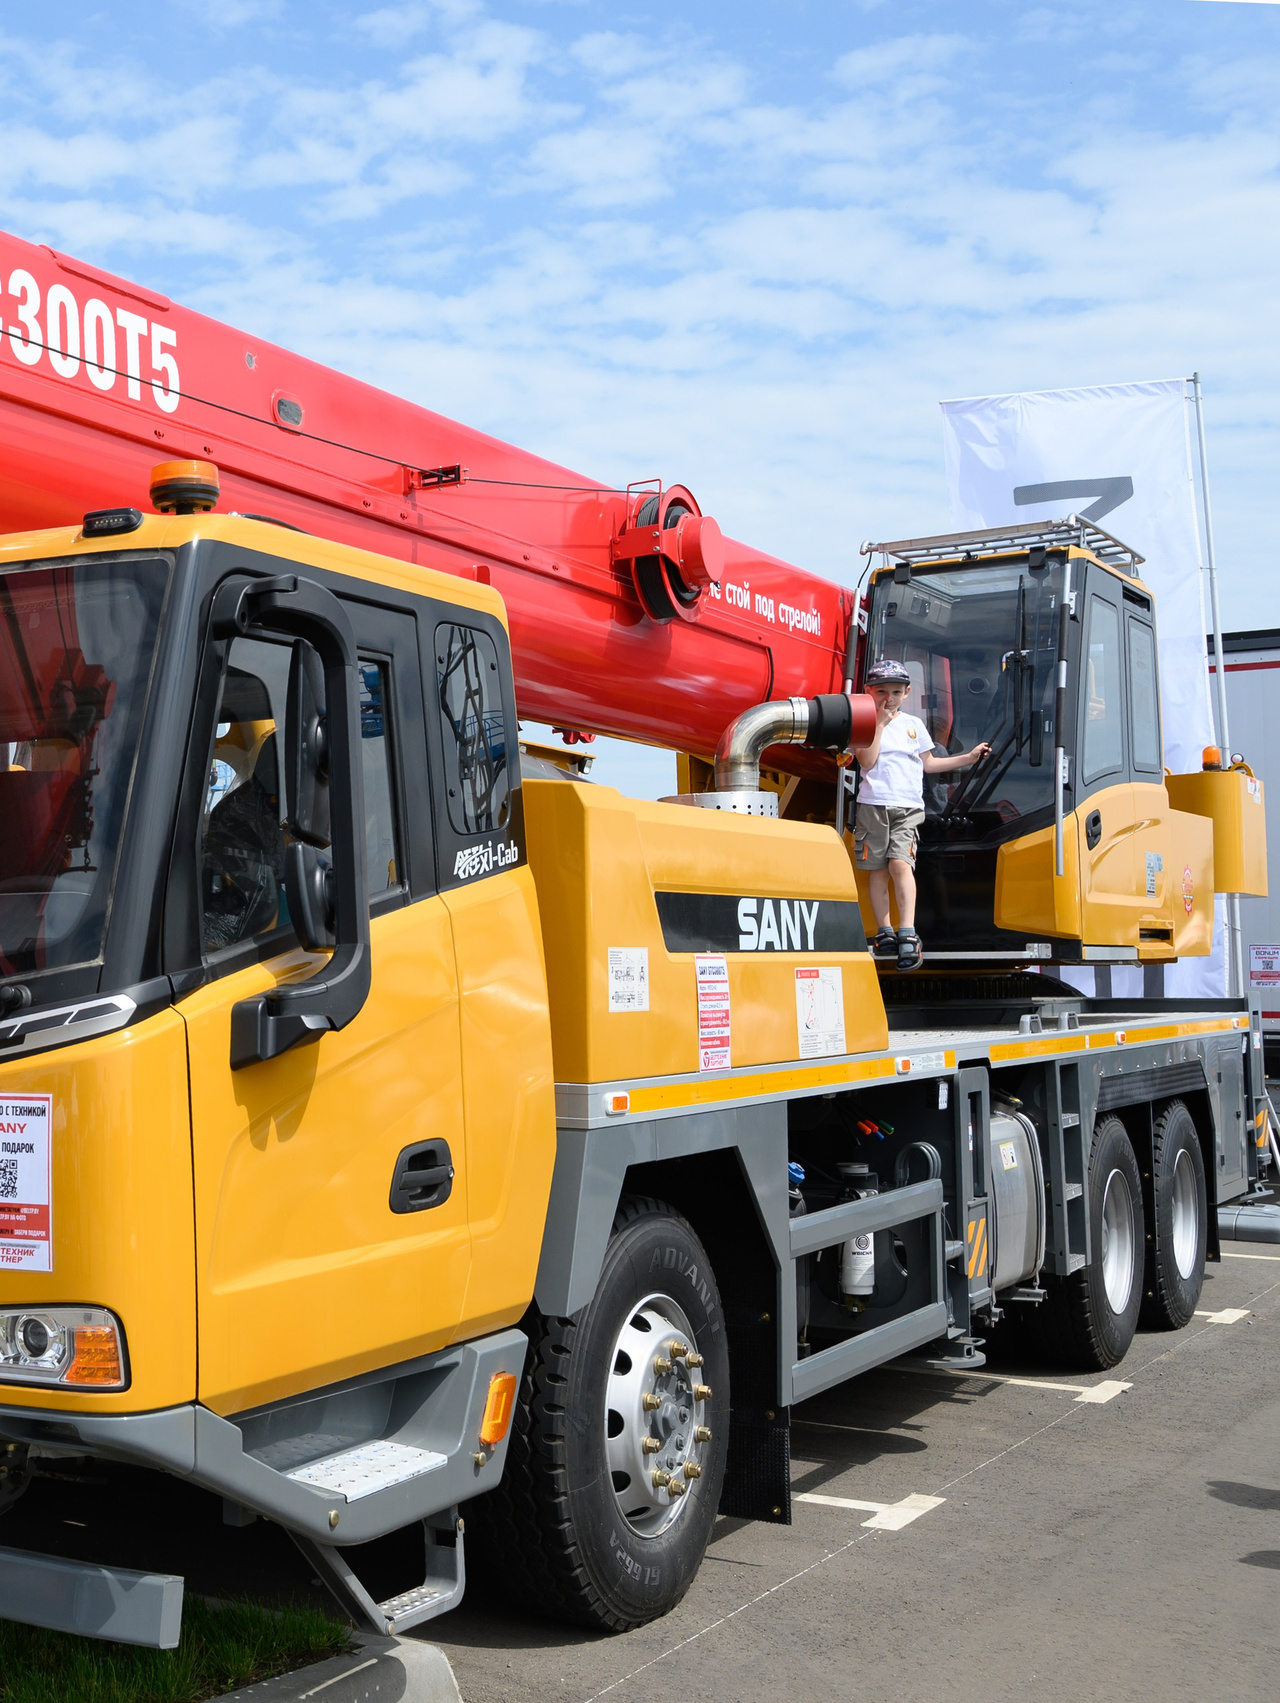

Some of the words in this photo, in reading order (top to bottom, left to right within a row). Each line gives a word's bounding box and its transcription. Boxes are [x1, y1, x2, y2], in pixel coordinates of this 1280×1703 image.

[725, 581, 751, 611] стой
[755, 593, 775, 624] под
[778, 602, 821, 637] стрелой!
[737, 897, 820, 951] SANY
[5, 1106, 10, 1116] С
[11, 1105, 47, 1117] ТЕХНИКОЙ
[1, 1142, 35, 1154] ПОДАРОК
